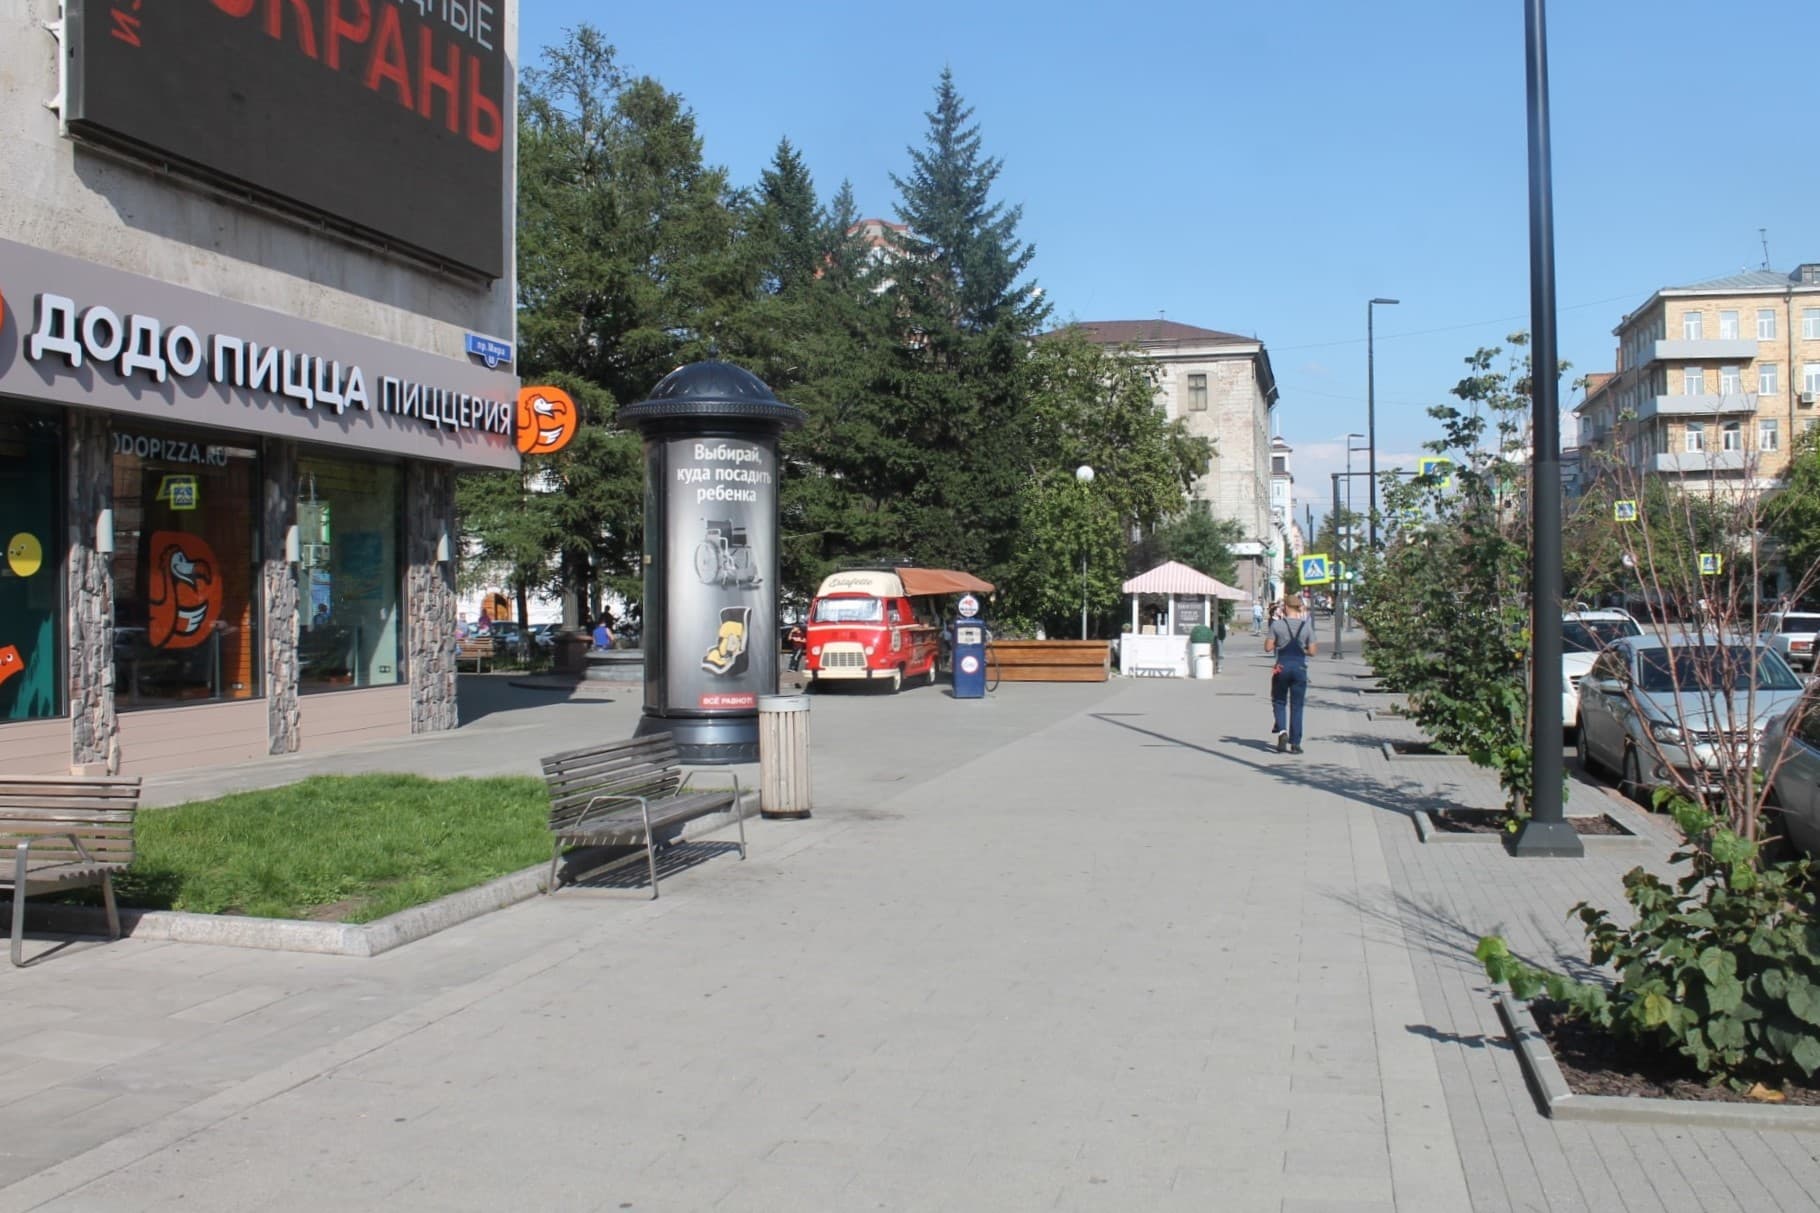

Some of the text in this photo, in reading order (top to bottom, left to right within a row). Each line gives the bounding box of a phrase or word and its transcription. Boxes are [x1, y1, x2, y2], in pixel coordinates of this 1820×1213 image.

[31, 293, 511, 435] ДОДО ПИЦЦА ПИЦЦЕРИЯ
[694, 444, 762, 464] Выбирай,
[676, 468, 772, 484] куда посадить
[697, 485, 757, 504] ребенка
